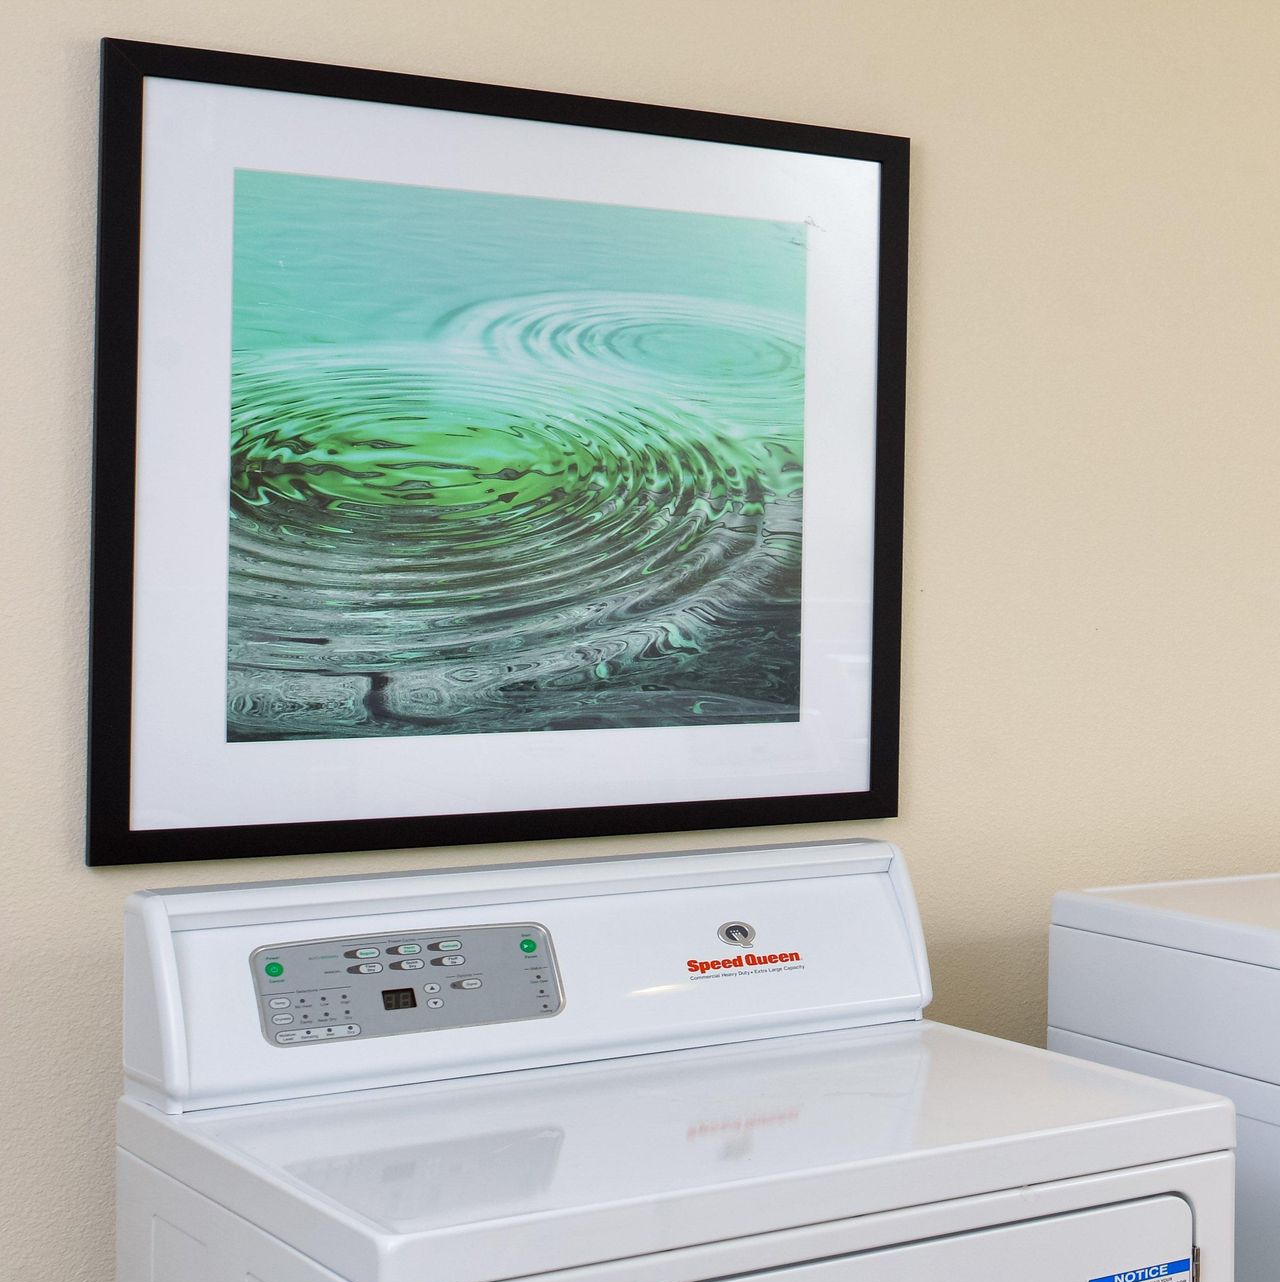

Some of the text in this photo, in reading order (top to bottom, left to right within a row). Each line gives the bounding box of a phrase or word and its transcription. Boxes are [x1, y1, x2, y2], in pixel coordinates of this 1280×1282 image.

[687, 952, 800, 974] Speed Queen
[690, 973, 720, 981] Commercial
[768, 966, 782, 974] Large
[783, 964, 805, 972] Capacity
